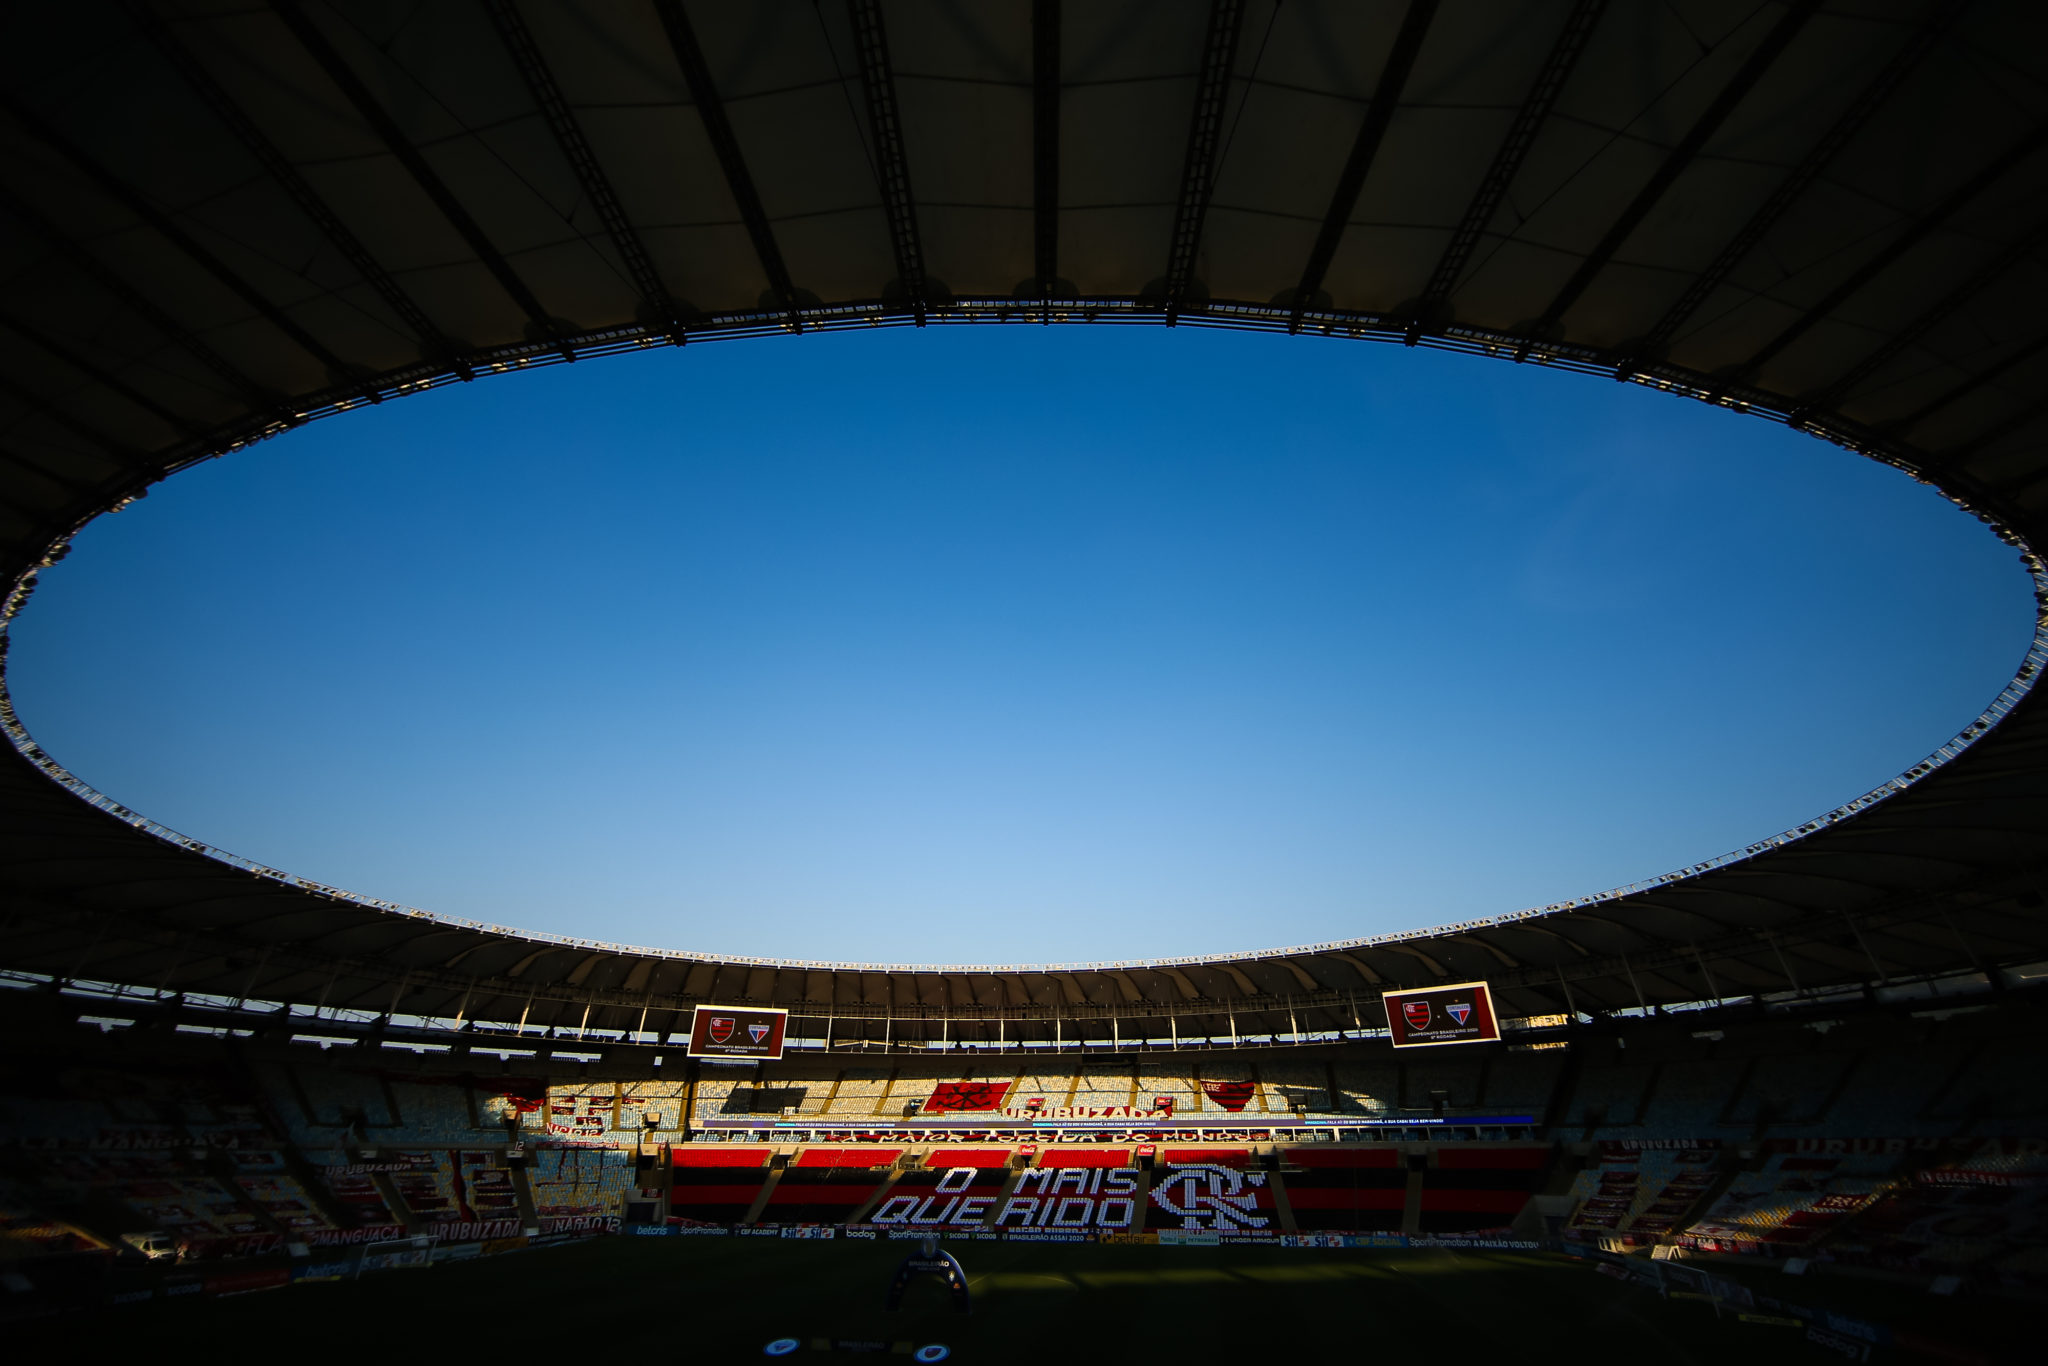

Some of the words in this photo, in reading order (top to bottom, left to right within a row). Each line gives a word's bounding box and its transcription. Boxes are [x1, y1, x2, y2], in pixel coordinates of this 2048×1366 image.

[1111, 1133, 1150, 1143] DO
[935, 1167, 978, 1194] O
[1013, 1167, 1139, 1195] MAIS
[636, 1226, 669, 1236] betcris
[680, 1226, 729, 1236] SportPromotion
[846, 1229, 877, 1240] bodog
[888, 1230, 941, 1241] SportPromotion
[1285, 1236, 1298, 1247] Sil
[1315, 1236, 1328, 1247] Sil
[1409, 1237, 1472, 1249] SportPromotion
[1480, 1238, 1509, 1248] PAIXÃO
[1807, 1327, 1858, 1360] bodog
